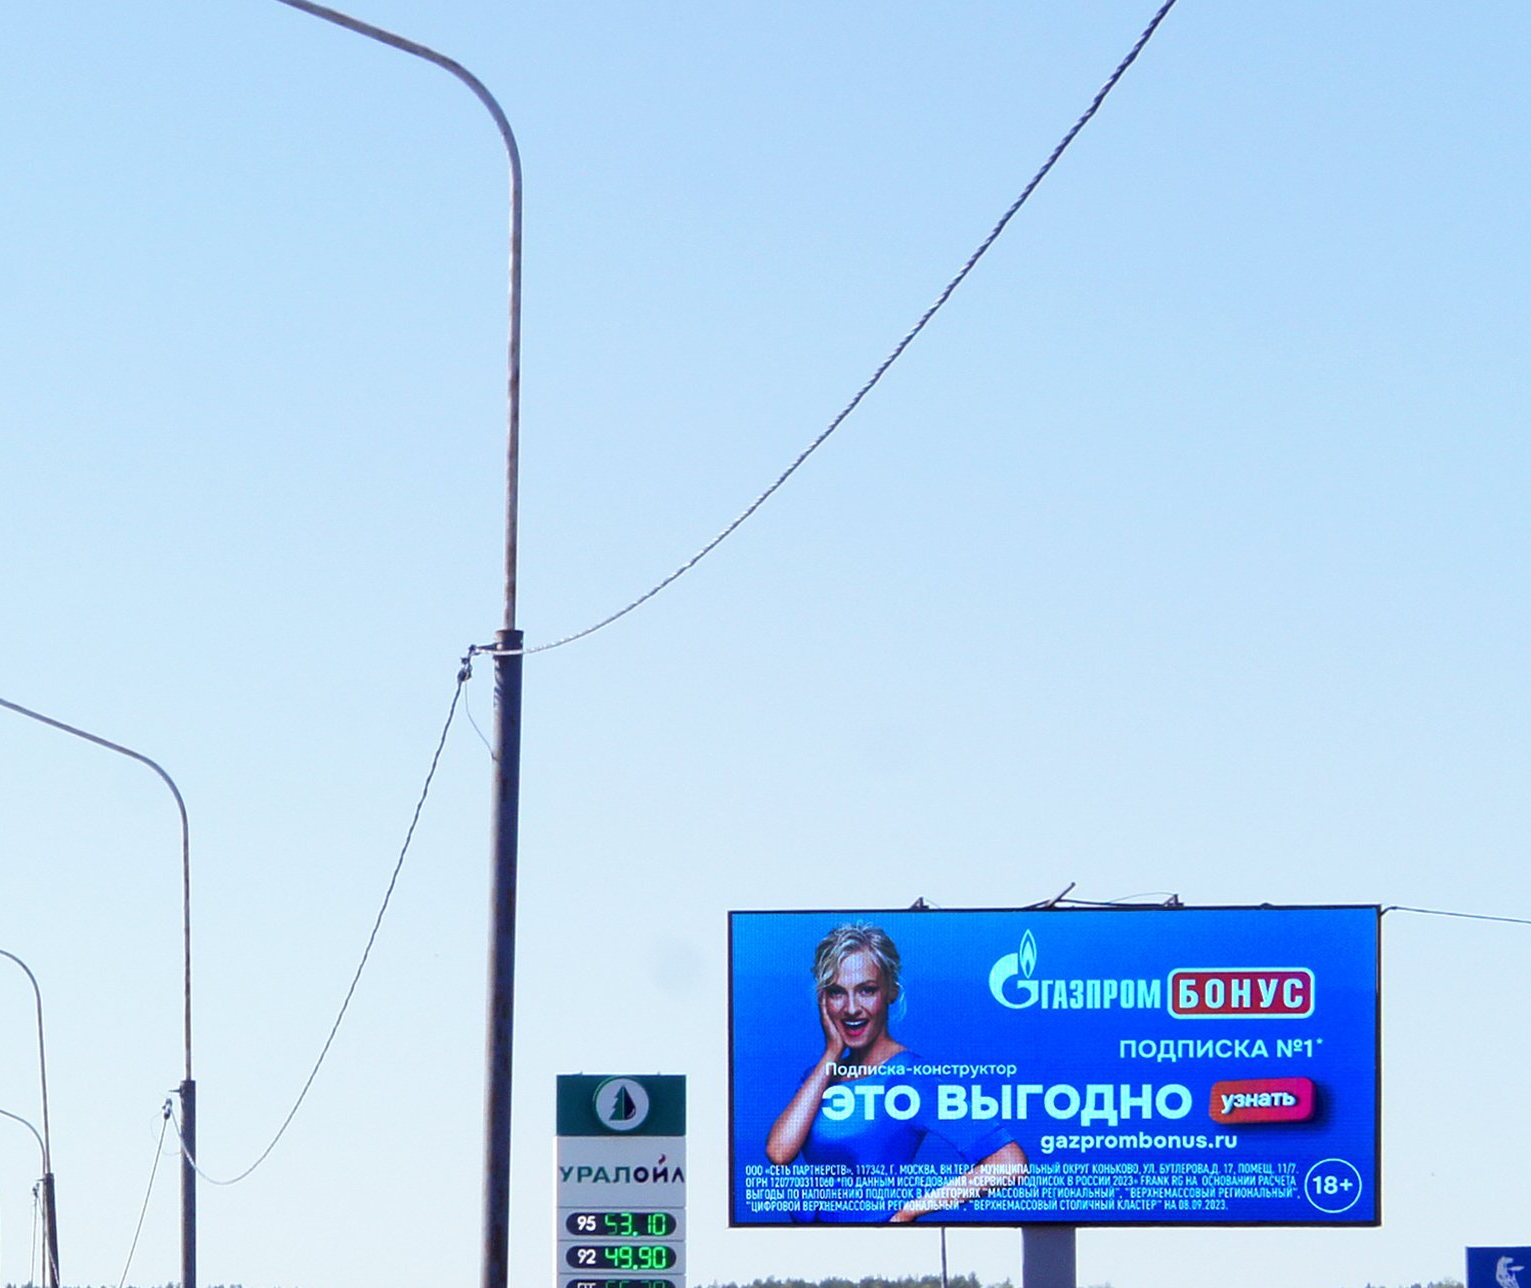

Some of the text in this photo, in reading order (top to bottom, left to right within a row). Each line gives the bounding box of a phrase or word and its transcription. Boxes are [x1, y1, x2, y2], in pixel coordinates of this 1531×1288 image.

[1040, 978, 1304, 1009] ГАЗПРОМ БОНУС
[1119, 1040, 1268, 1062] ПОДПИСКА
[825, 1061, 1017, 1078] Подписка-конструктор
[822, 1084, 1193, 1126] ЭТО ВЫГОДНО
[1221, 1090, 1296, 1115] узнать
[1041, 1131, 1238, 1155] gazprombonus.ru
[559, 1154, 685, 1183] УРАЛОЙЛ
[745, 1165, 763, 1176] ООО
[765, 1165, 791, 1176] «СЕТЬ
[900, 1164, 938, 1175] МОСКВА,
[980, 1162, 1060, 1175] МУНИЦИПАЛЬНЫЙ
[1063, 1164, 1089, 1174] ОКРУГ
[1092, 1163, 1141, 1175] КОНЬКОВО,
[1143, 1163, 1157, 1174] УЛ.
[1238, 1163, 1275, 1175] ПОМЕЩ.
[745, 1177, 768, 1187] ОГРН
[855, 1177, 895, 1188] ДАННЫМ
[897, 1176, 967, 1187] ИССЛЕДОВАНИЯ
[968, 1176, 1016, 1186] «СЕРВИСЫ
[1017, 1176, 1065, 1187] ПОДПИСОК
[1067, 1176, 1073, 1186] В
[1075, 1176, 1111, 1186] РОССИИ
[1140, 1175, 1170, 1186] FRANK
[1171, 1175, 1183, 1186] RG
[1185, 1175, 1198, 1186] НА
[1201, 1175, 1256, 1186] ОСНОВАНИИ
[1258, 1175, 1297, 1186] РАСЧЕТА
[1312, 1176, 1353, 1195] 18+
[746, 1189, 785, 1201] ВЫГОДЫ
[787, 1189, 799, 1199] ПО
[801, 1189, 863, 1199] НАПОЛНЕНИЮ
[865, 1188, 913, 1200] ПОДПИСОК
[916, 1188, 923, 1198] В
[924, 1188, 981, 1198] КАТЕГОРИЯХ
[802, 1200, 886, 1211] ВЕРХНЕМАССОВЫЙ
[1059, 1199, 1115, 1211] СТОЛИЧНЫЙ
[1164, 1199, 1177, 1210] НА
[577, 1213, 667, 1237] 95 53.10
[577, 1245, 667, 1270] 92 49.90
